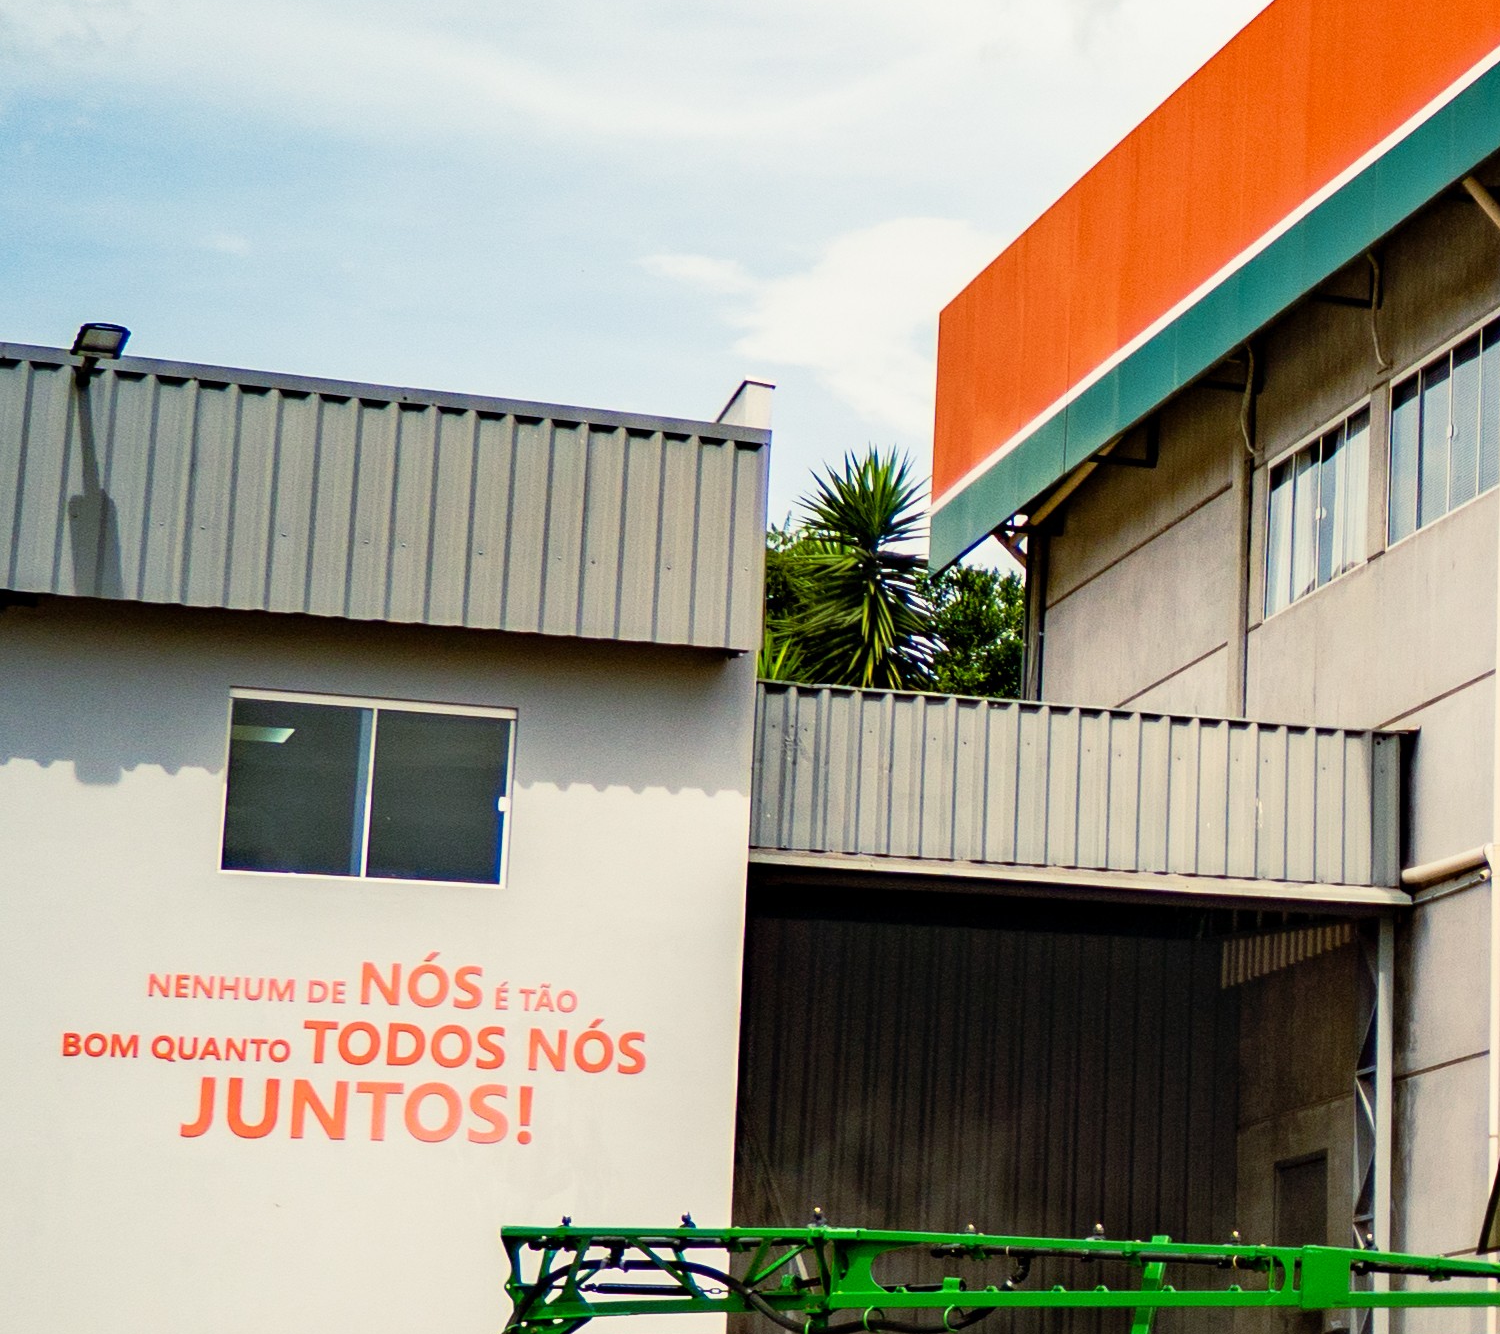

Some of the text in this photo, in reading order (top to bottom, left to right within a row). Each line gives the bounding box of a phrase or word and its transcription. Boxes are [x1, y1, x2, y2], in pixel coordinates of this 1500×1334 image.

[148, 952, 578, 1013] NENHUM DE NÓS É TÃO
[62, 1019, 646, 1075] BOM QUANTO TODOS NÓS
[180, 1076, 534, 1145] JUNTOS!
